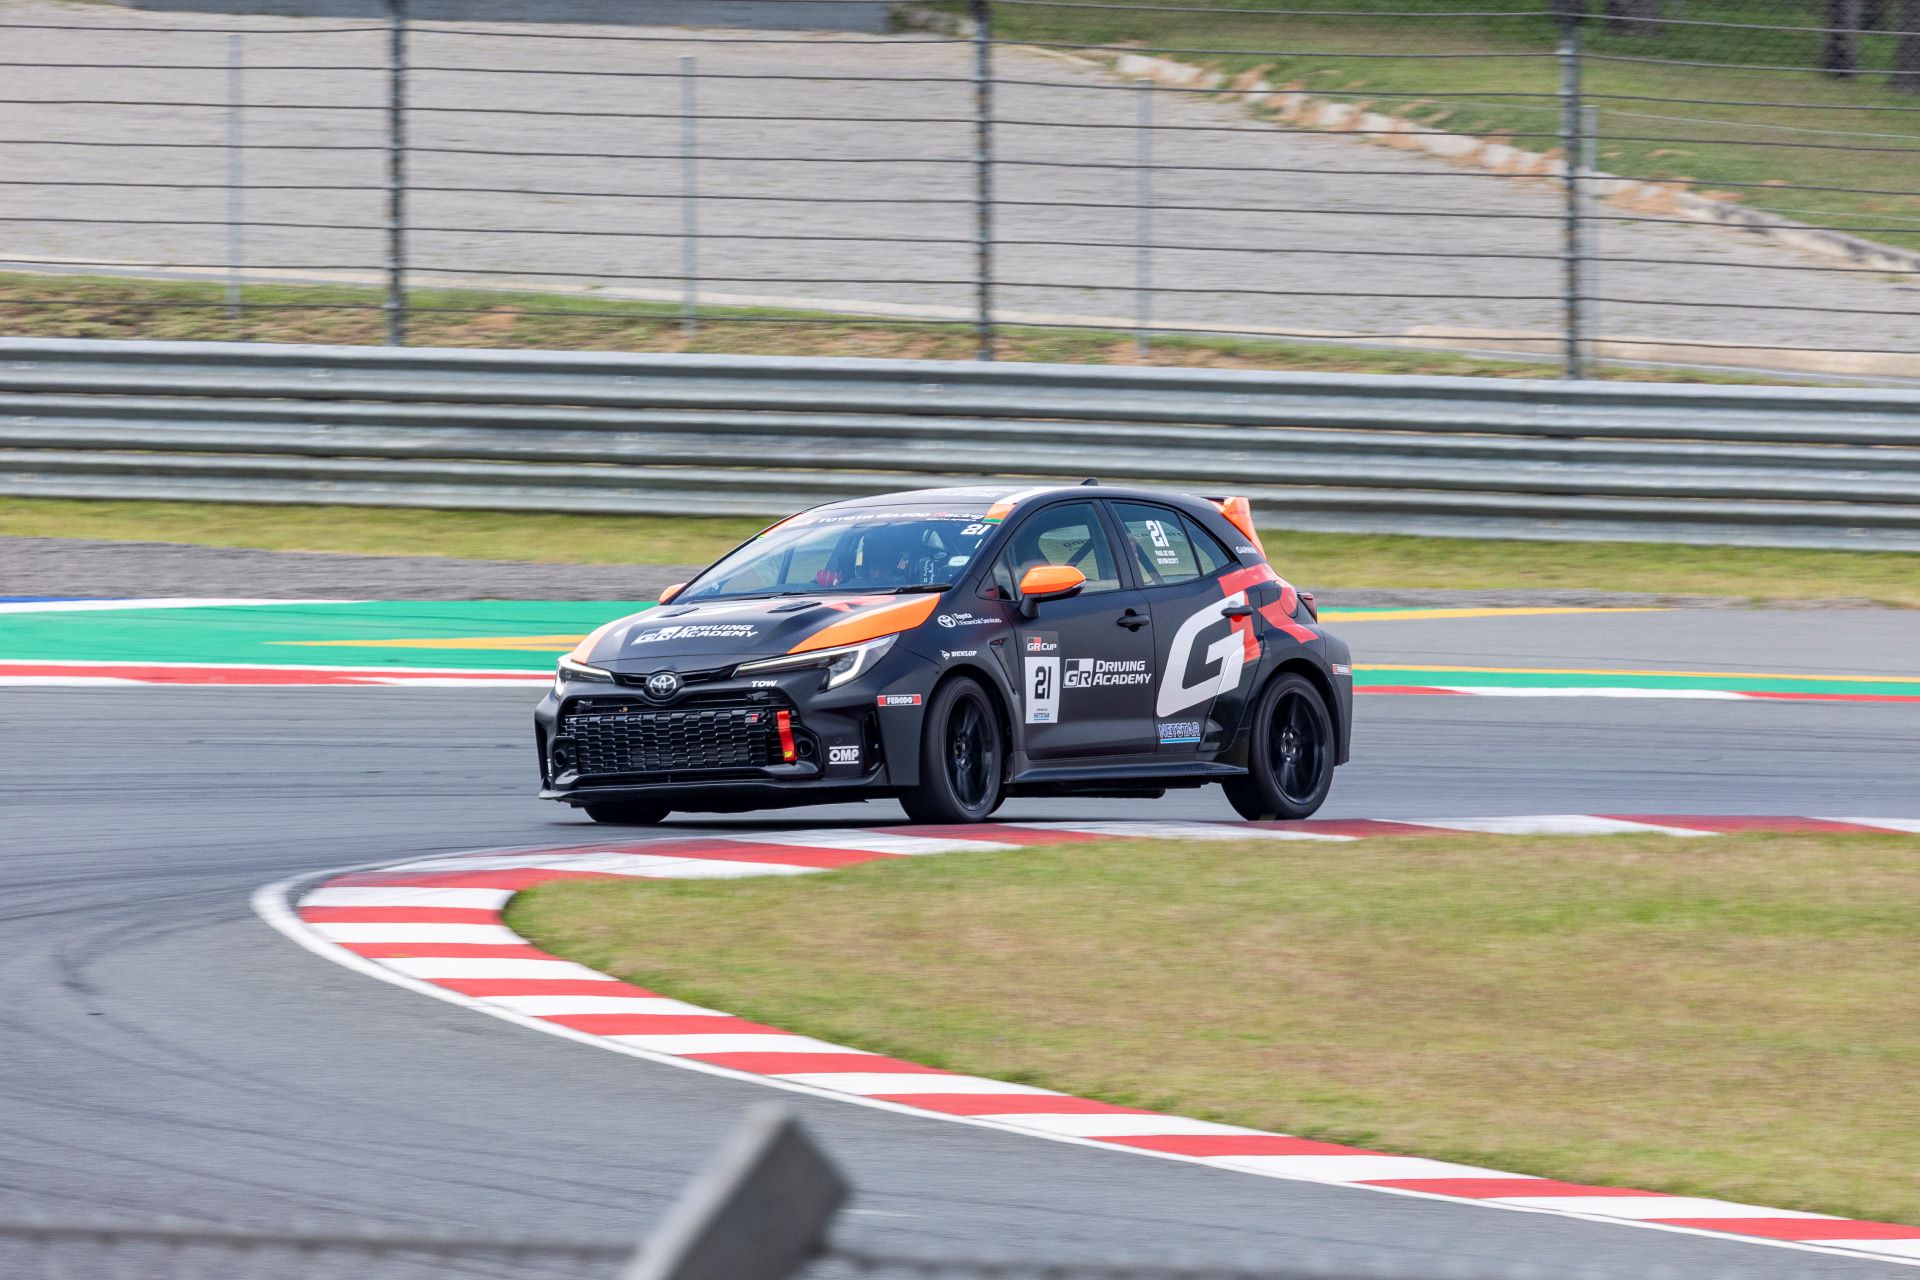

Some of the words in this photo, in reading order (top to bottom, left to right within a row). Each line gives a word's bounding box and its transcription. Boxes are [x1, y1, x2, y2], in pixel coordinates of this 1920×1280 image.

[960, 523, 992, 535] 21
[1145, 520, 1170, 547] 21
[672, 630, 759, 639] ACADEMY
[1027, 642, 1041, 651] GR
[1095, 660, 1146, 672] DRIVING
[1034, 666, 1052, 699] 21
[1092, 673, 1152, 686] ACADEMY
[1158, 722, 1200, 738] NETSTAR
[829, 750, 859, 762] OMP
